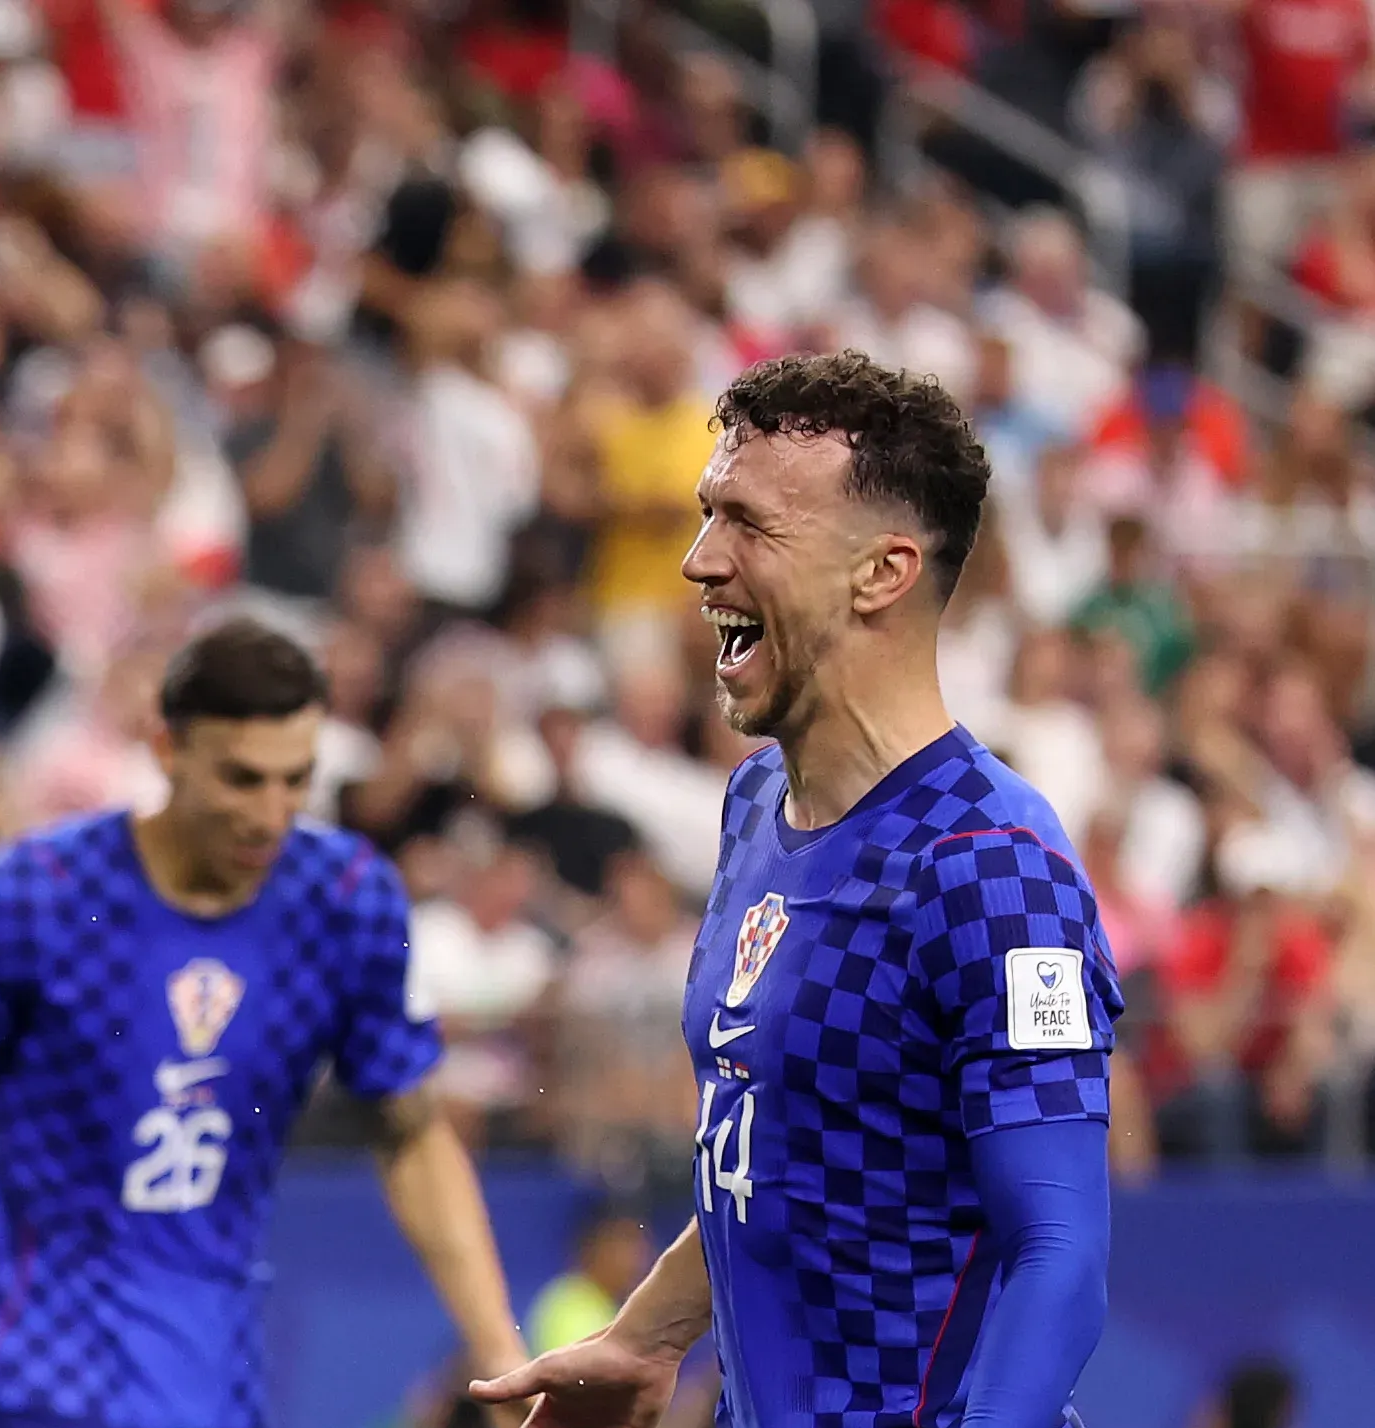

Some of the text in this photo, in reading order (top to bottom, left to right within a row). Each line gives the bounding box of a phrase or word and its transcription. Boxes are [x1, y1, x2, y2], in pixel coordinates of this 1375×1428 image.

[1030, 992, 1058, 1009] Unite
[1034, 1010, 1071, 1026] PEACE
[1042, 1028, 1065, 1037] FIFA
[120, 1105, 234, 1213] 26
[695, 1080, 754, 1224] 14
